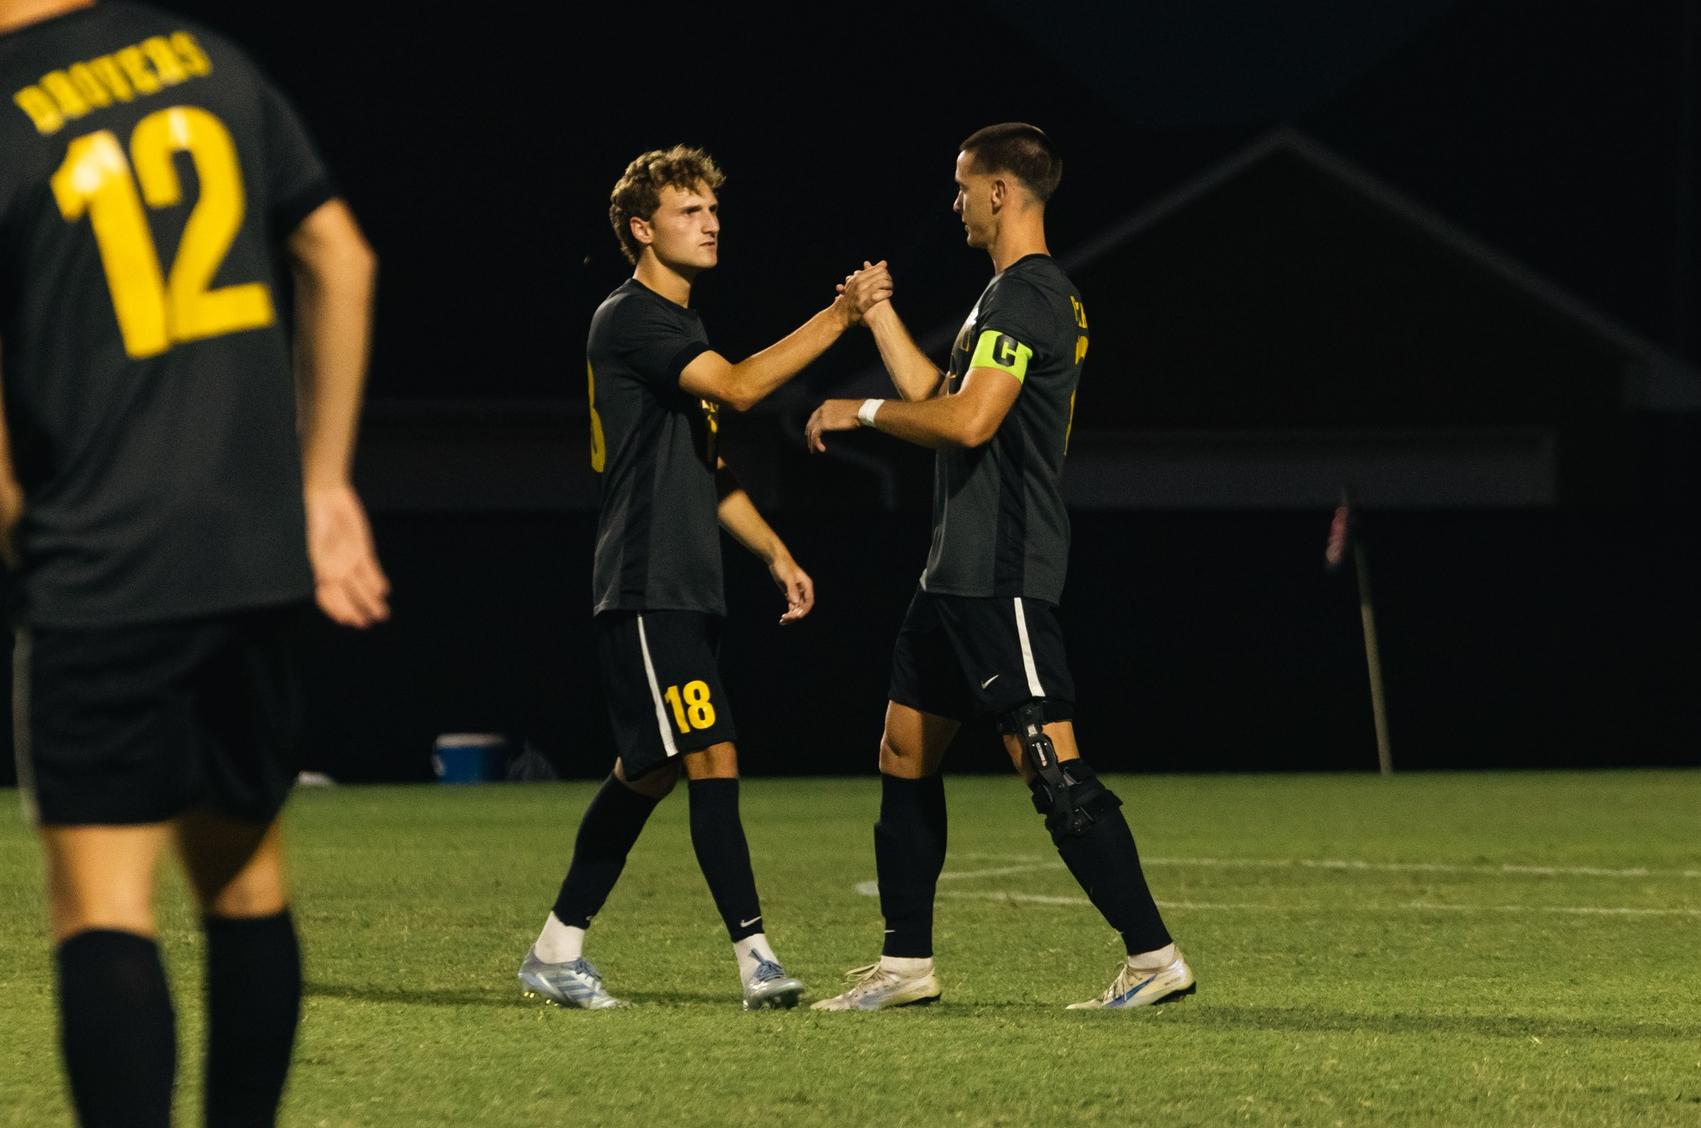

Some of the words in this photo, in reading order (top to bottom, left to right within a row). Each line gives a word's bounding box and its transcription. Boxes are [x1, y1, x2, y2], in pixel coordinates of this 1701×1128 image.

[51, 106, 274, 358] 12
[992, 333, 1019, 367] C
[664, 680, 716, 734] 18
